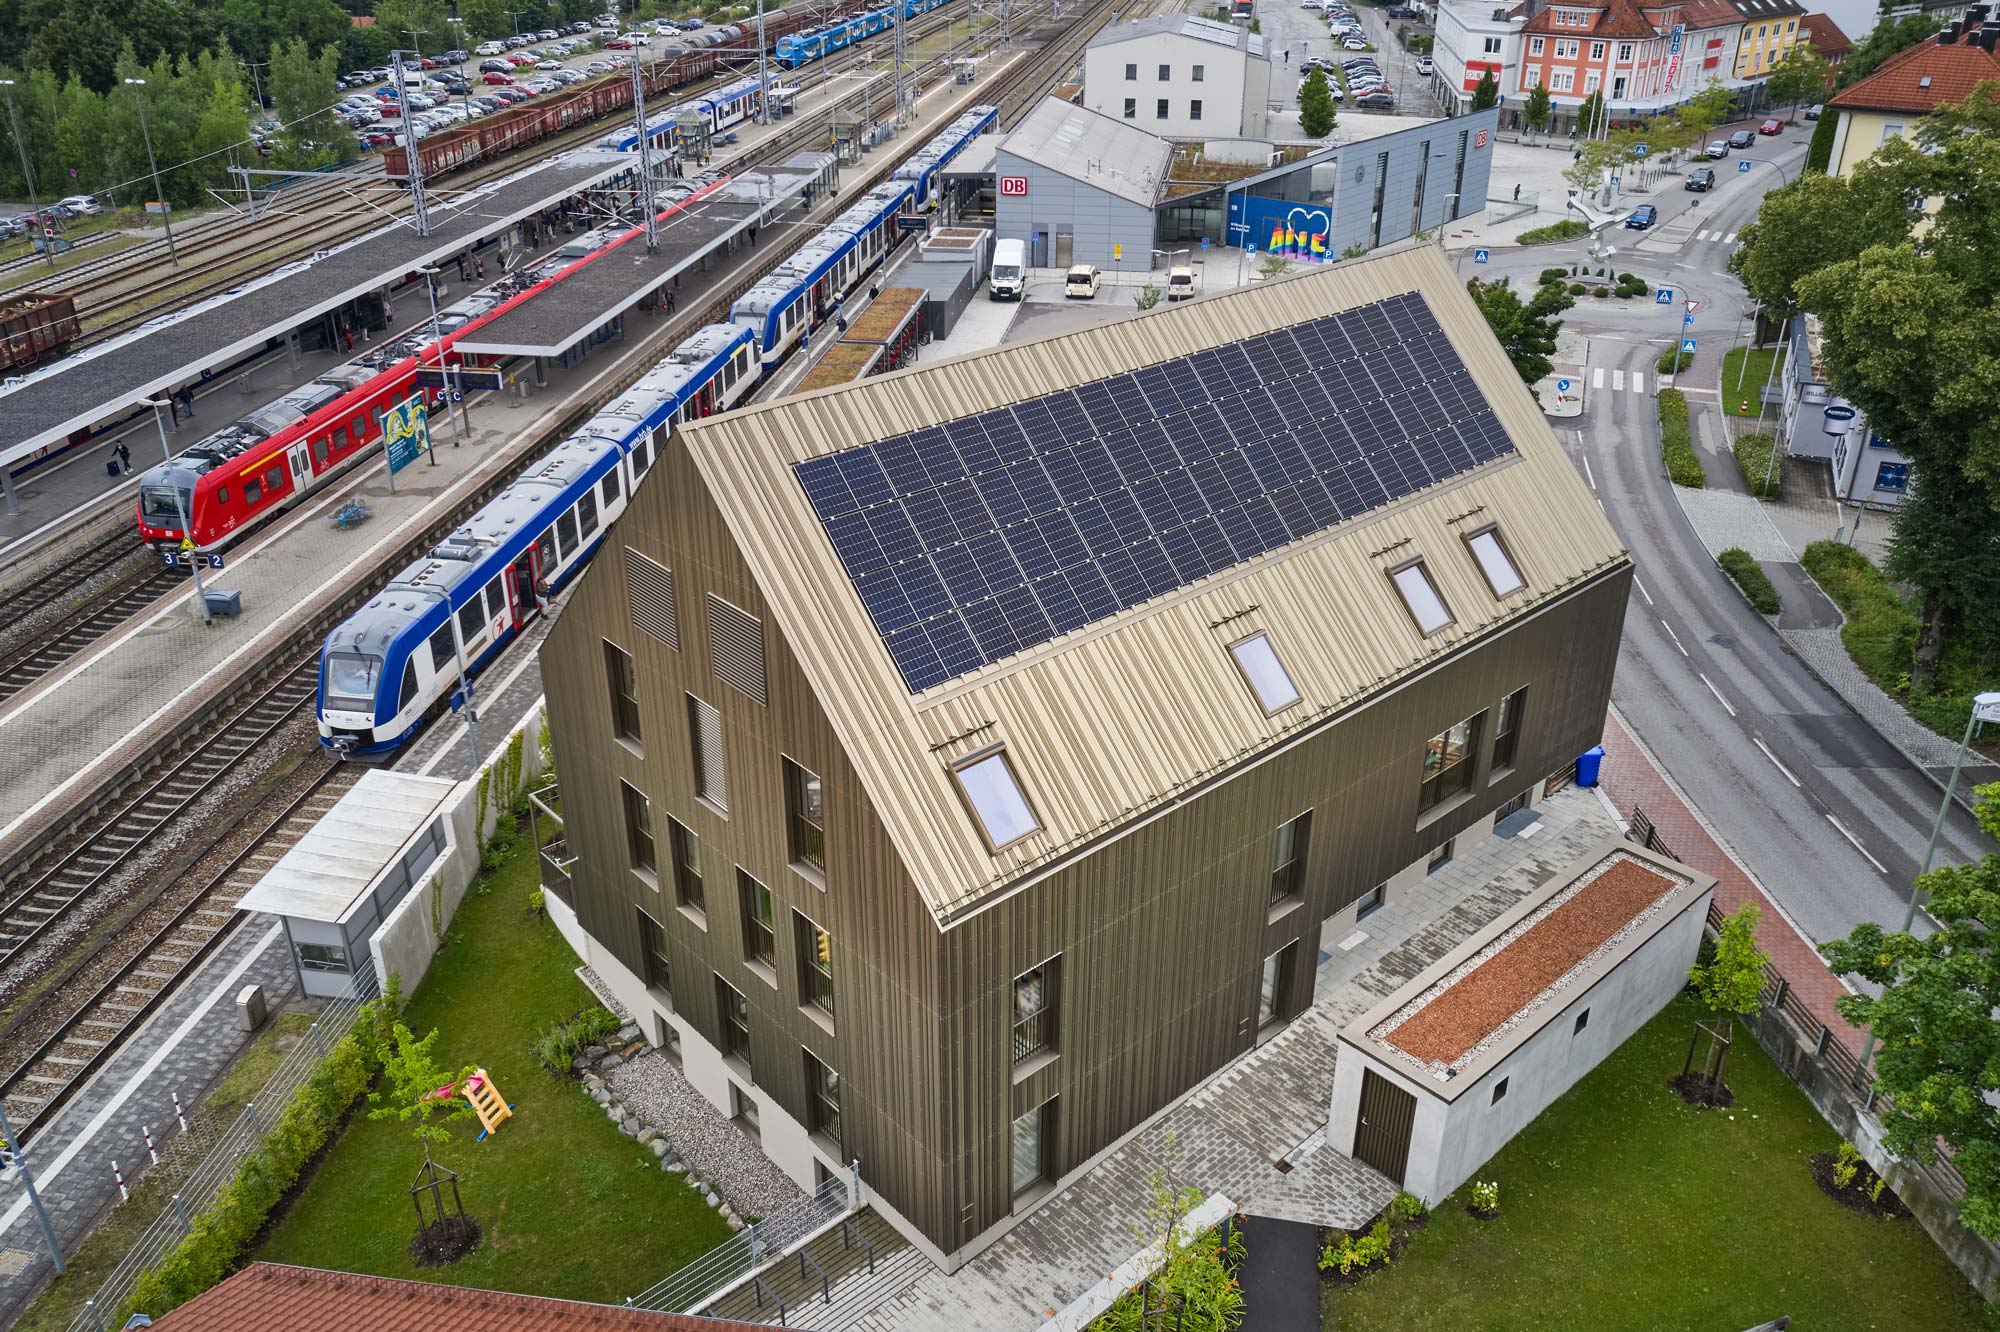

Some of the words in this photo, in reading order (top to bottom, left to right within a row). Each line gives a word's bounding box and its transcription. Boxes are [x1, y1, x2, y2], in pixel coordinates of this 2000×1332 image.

[1003, 179, 1025, 193] DB
[437, 391, 444, 400] C
[453, 392, 461, 401] C
[164, 553, 173, 564] 3
[212, 555, 222, 566] 2
